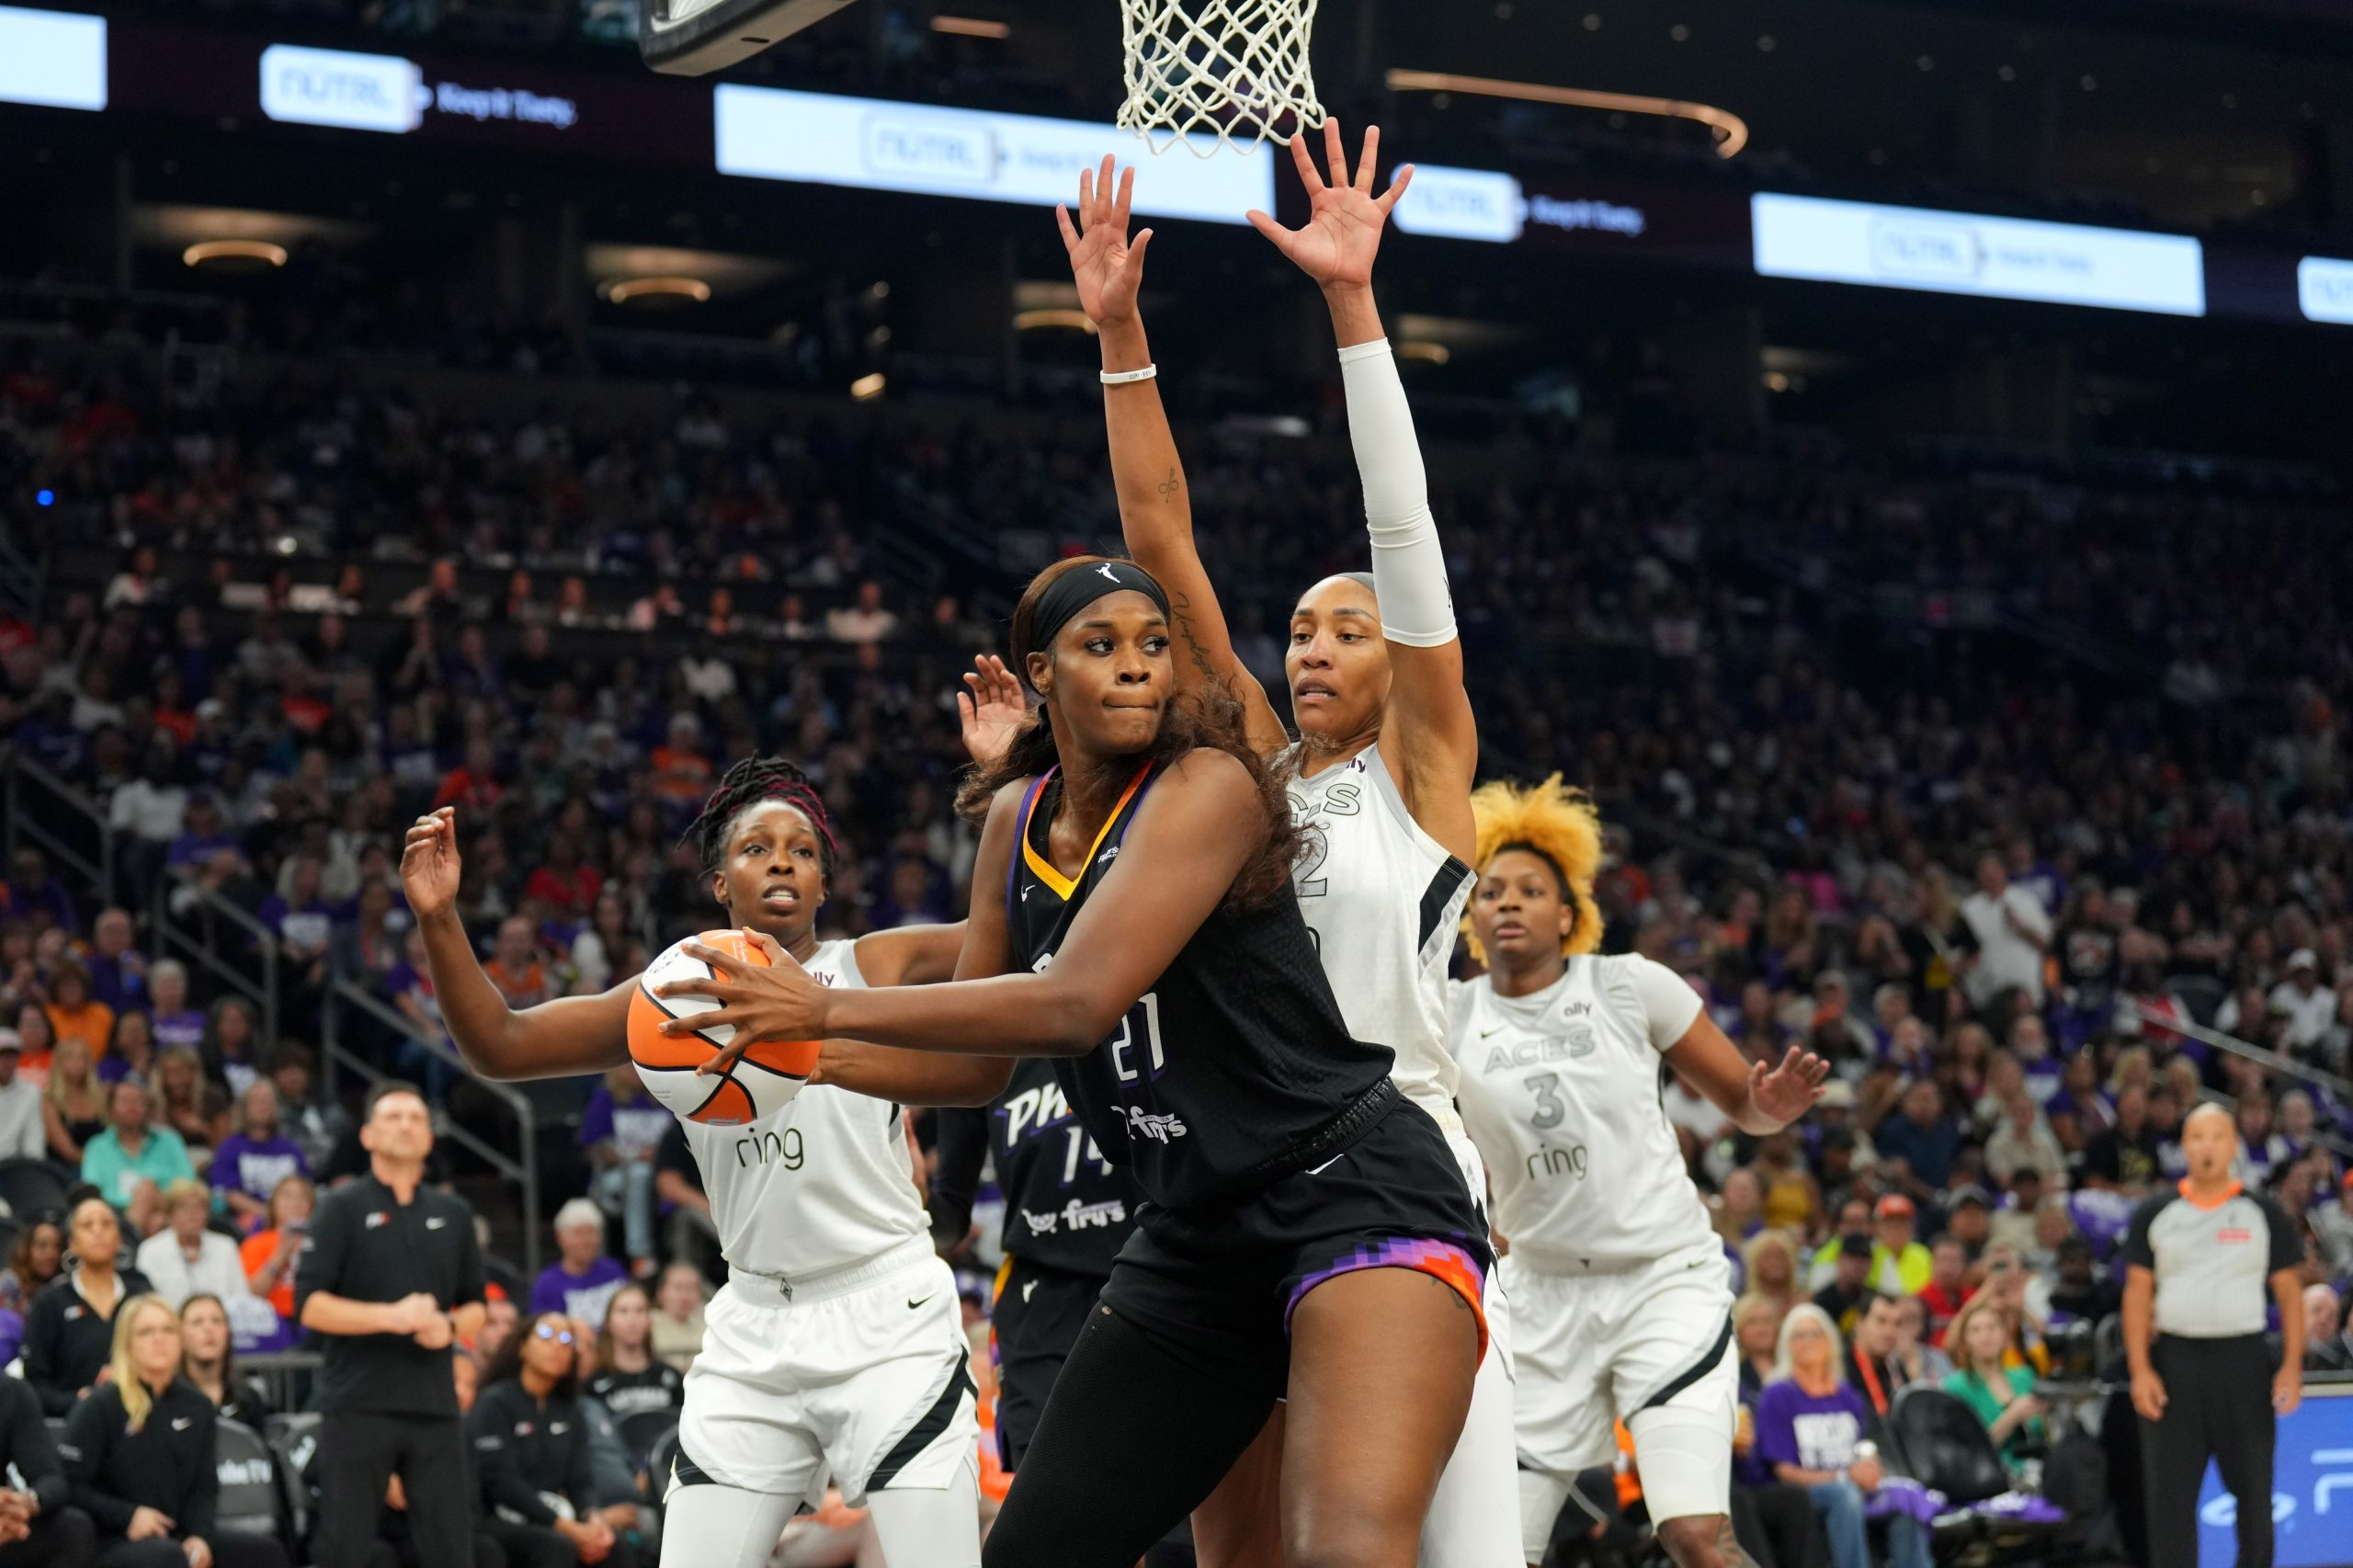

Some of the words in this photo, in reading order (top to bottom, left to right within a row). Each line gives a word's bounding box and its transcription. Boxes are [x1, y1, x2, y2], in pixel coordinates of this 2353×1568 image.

[1563, 1001, 1593, 1018] ally
[1483, 1023, 1597, 1074] ACES
[1523, 1072, 1565, 1130] 3
[736, 1127, 804, 1171] ring
[1526, 1142, 1588, 1181] ring
